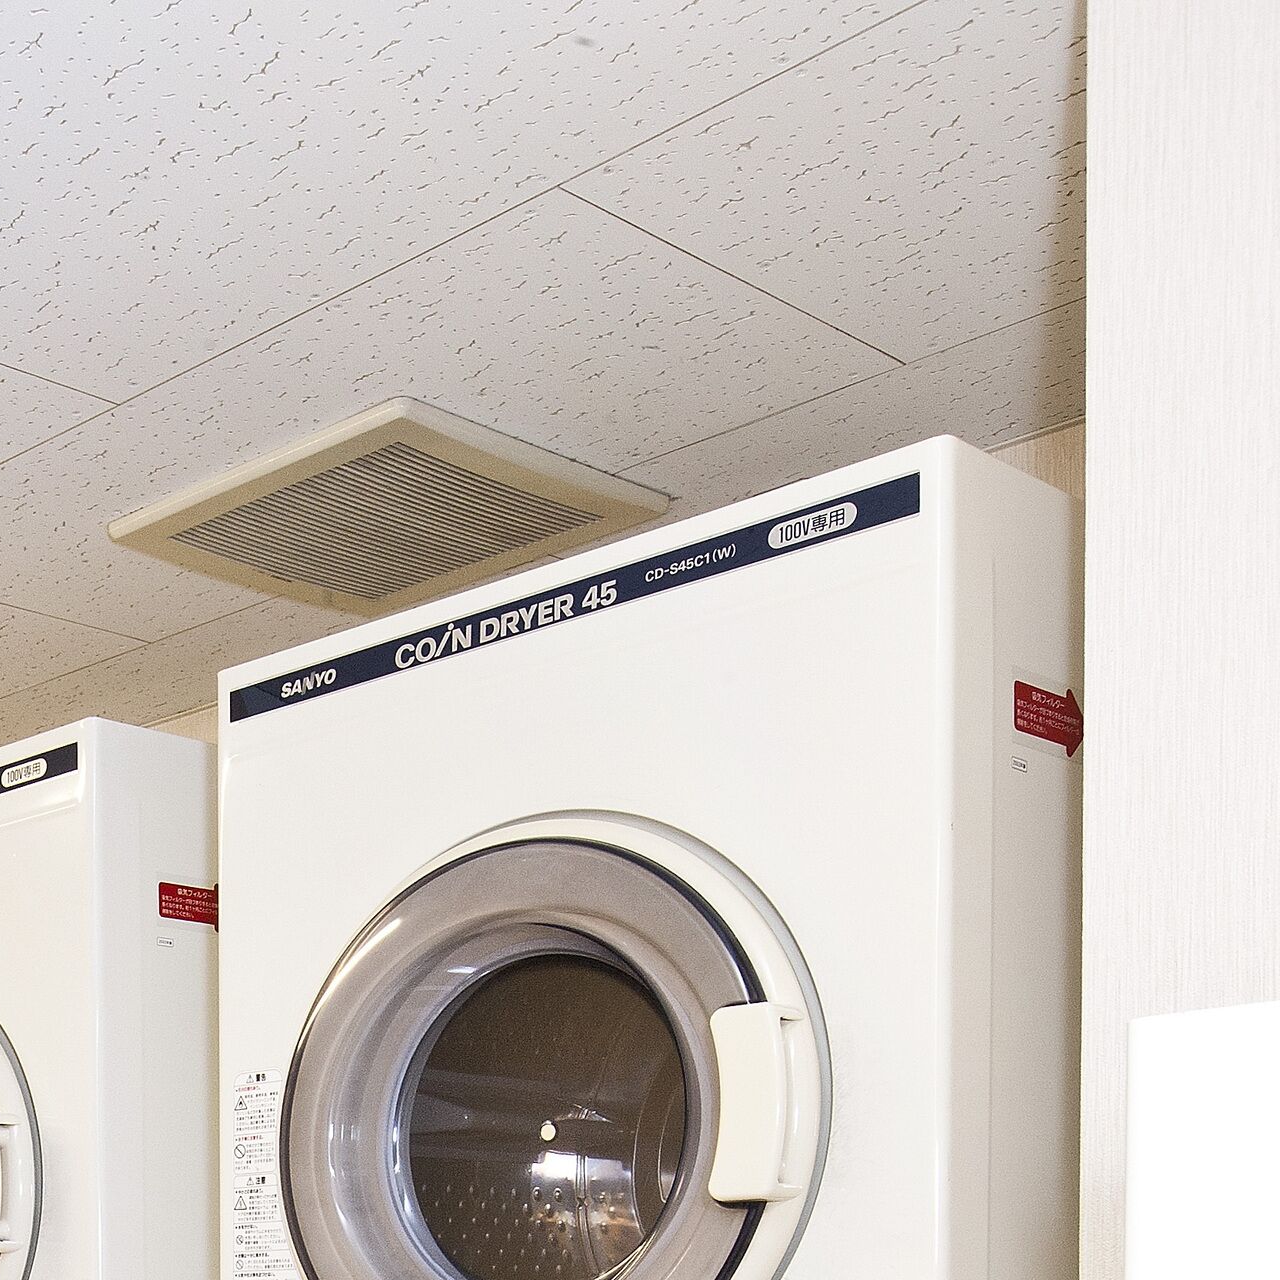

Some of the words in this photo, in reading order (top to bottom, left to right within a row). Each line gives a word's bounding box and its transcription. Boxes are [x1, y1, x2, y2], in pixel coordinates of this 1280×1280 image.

[778, 508, 845, 544] 100V専用
[645, 543, 737, 583] CD-S45C1(W)
[479, 594, 575, 644] DRYER
[582, 579, 618, 611] 45
[281, 668, 337, 699] SANYO
